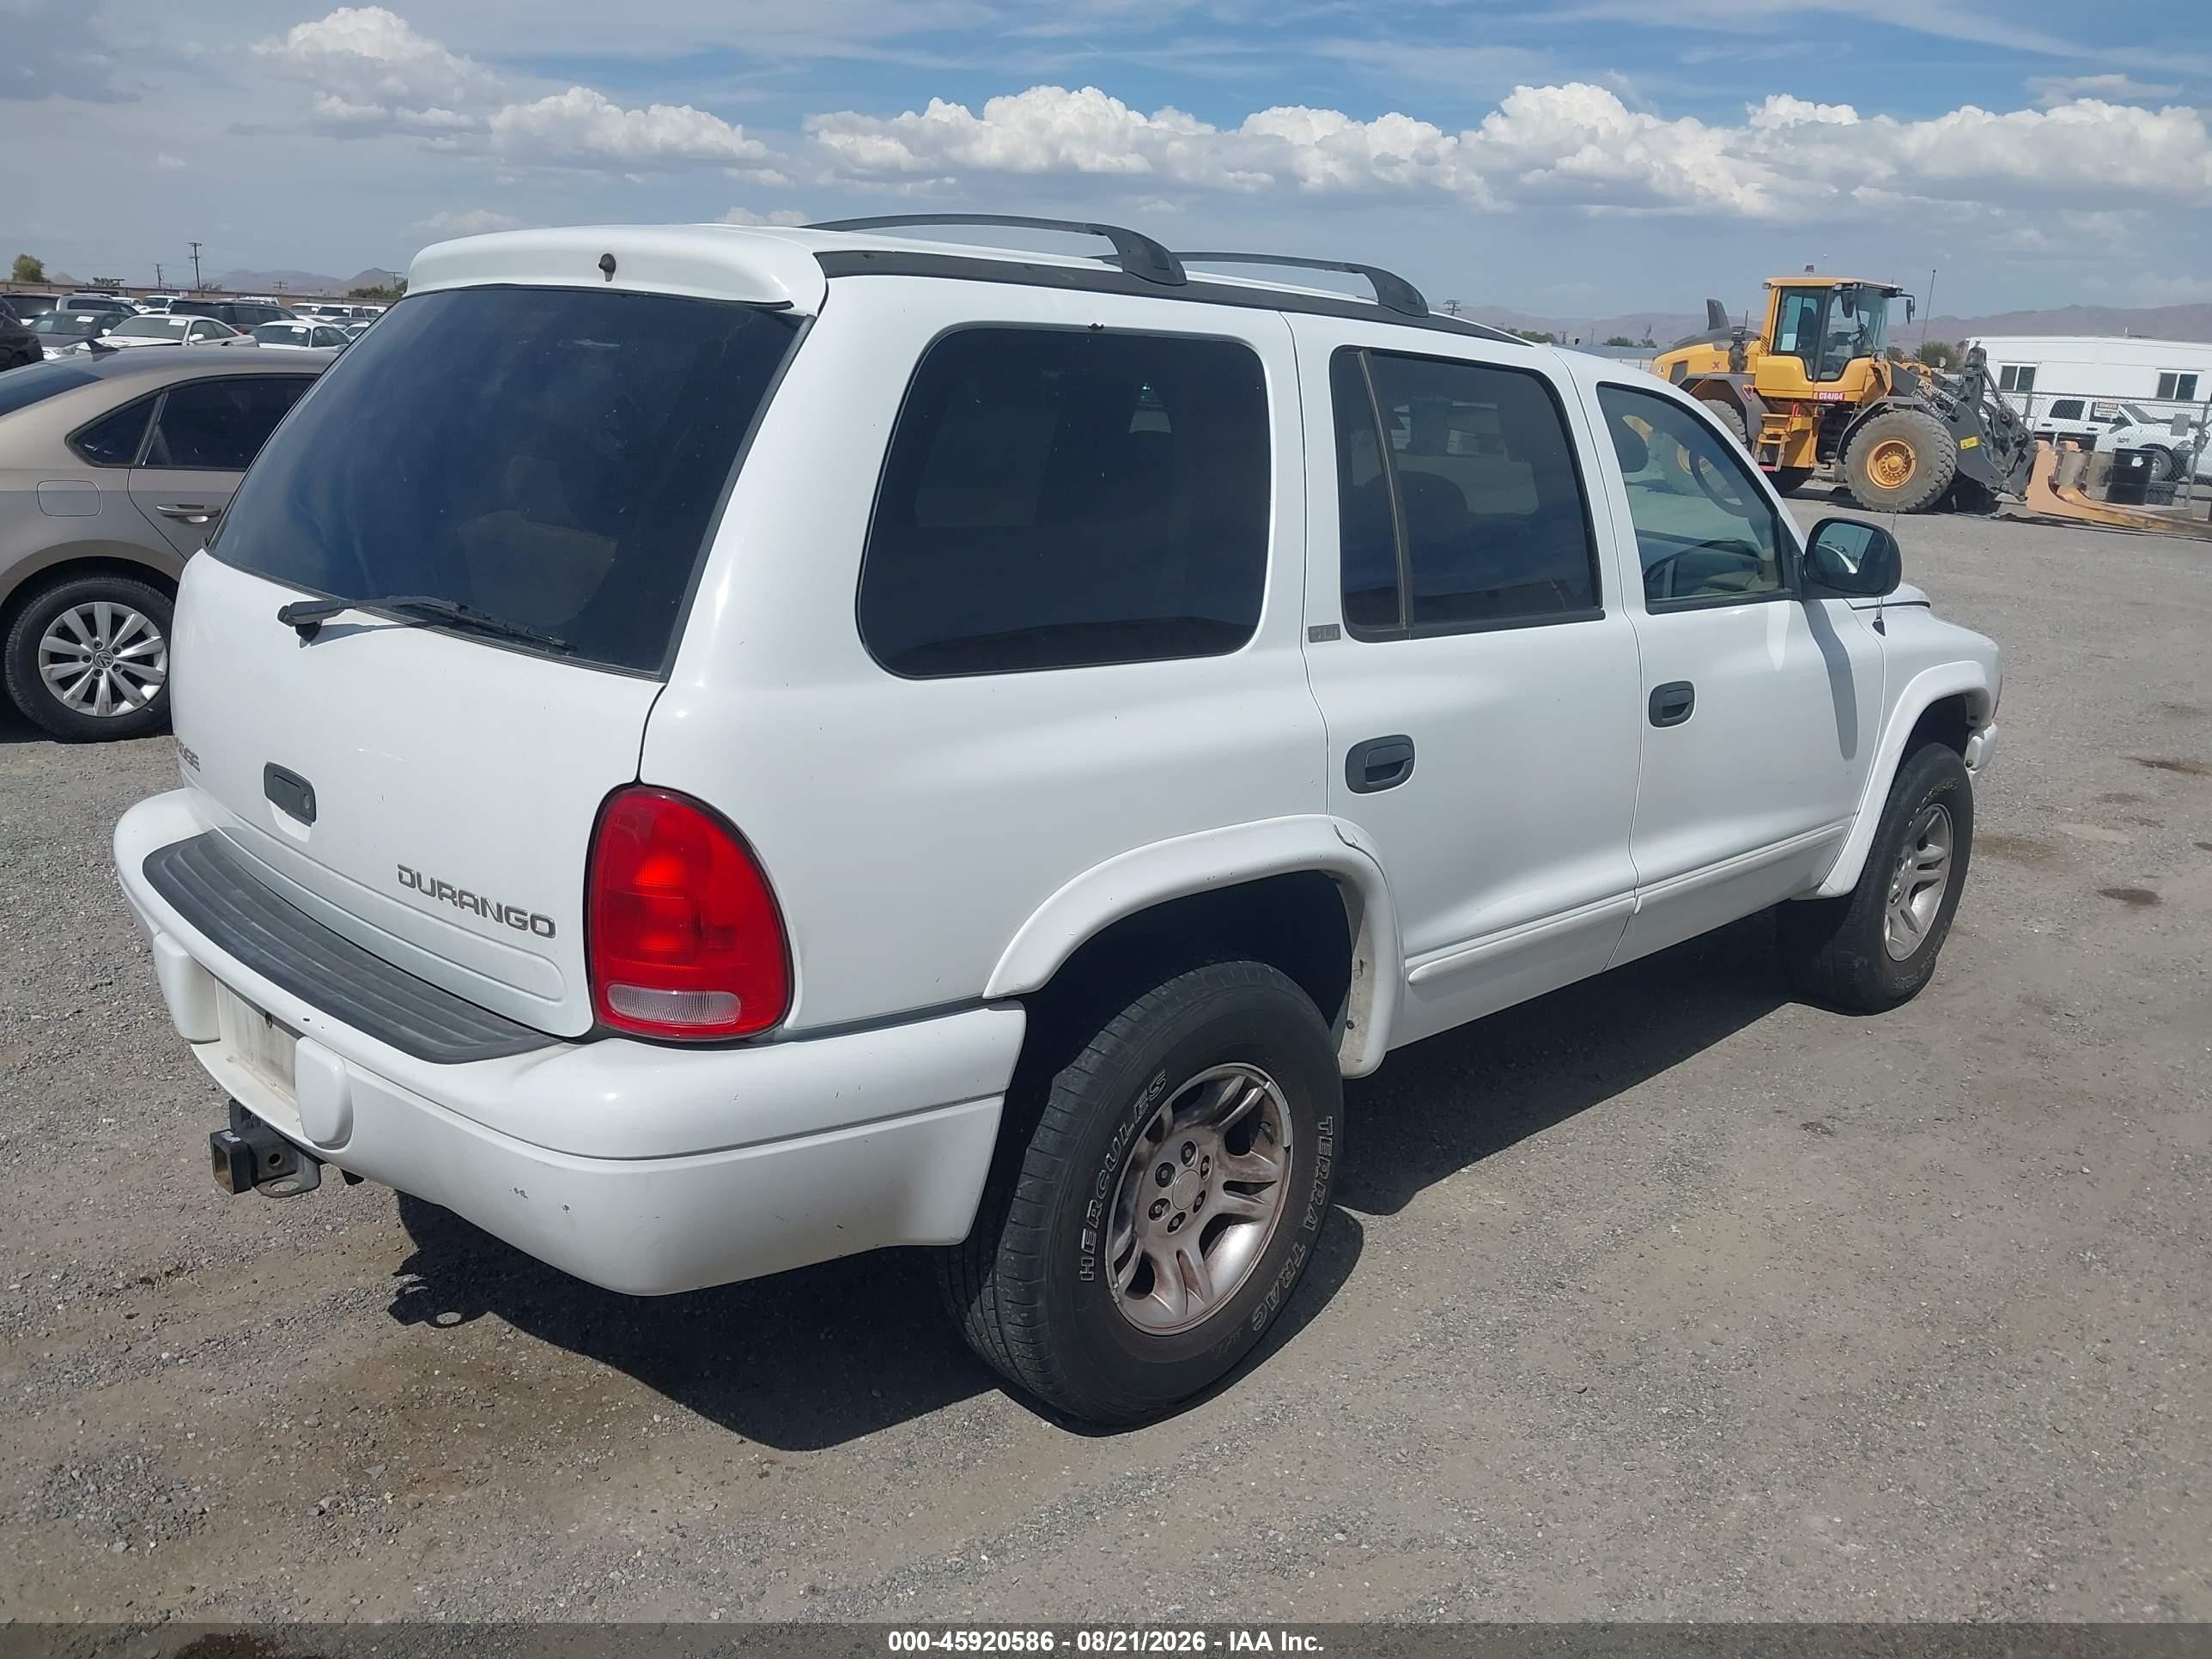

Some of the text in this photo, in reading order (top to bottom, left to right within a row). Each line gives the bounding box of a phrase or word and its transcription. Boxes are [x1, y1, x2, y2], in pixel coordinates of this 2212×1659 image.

[1941, 392, 1957, 405] WALK
[397, 863, 556, 939] DURANGO
[1079, 1070, 1167, 1281] HERCULES
[1251, 1115, 1334, 1331] TERRA TRAC
